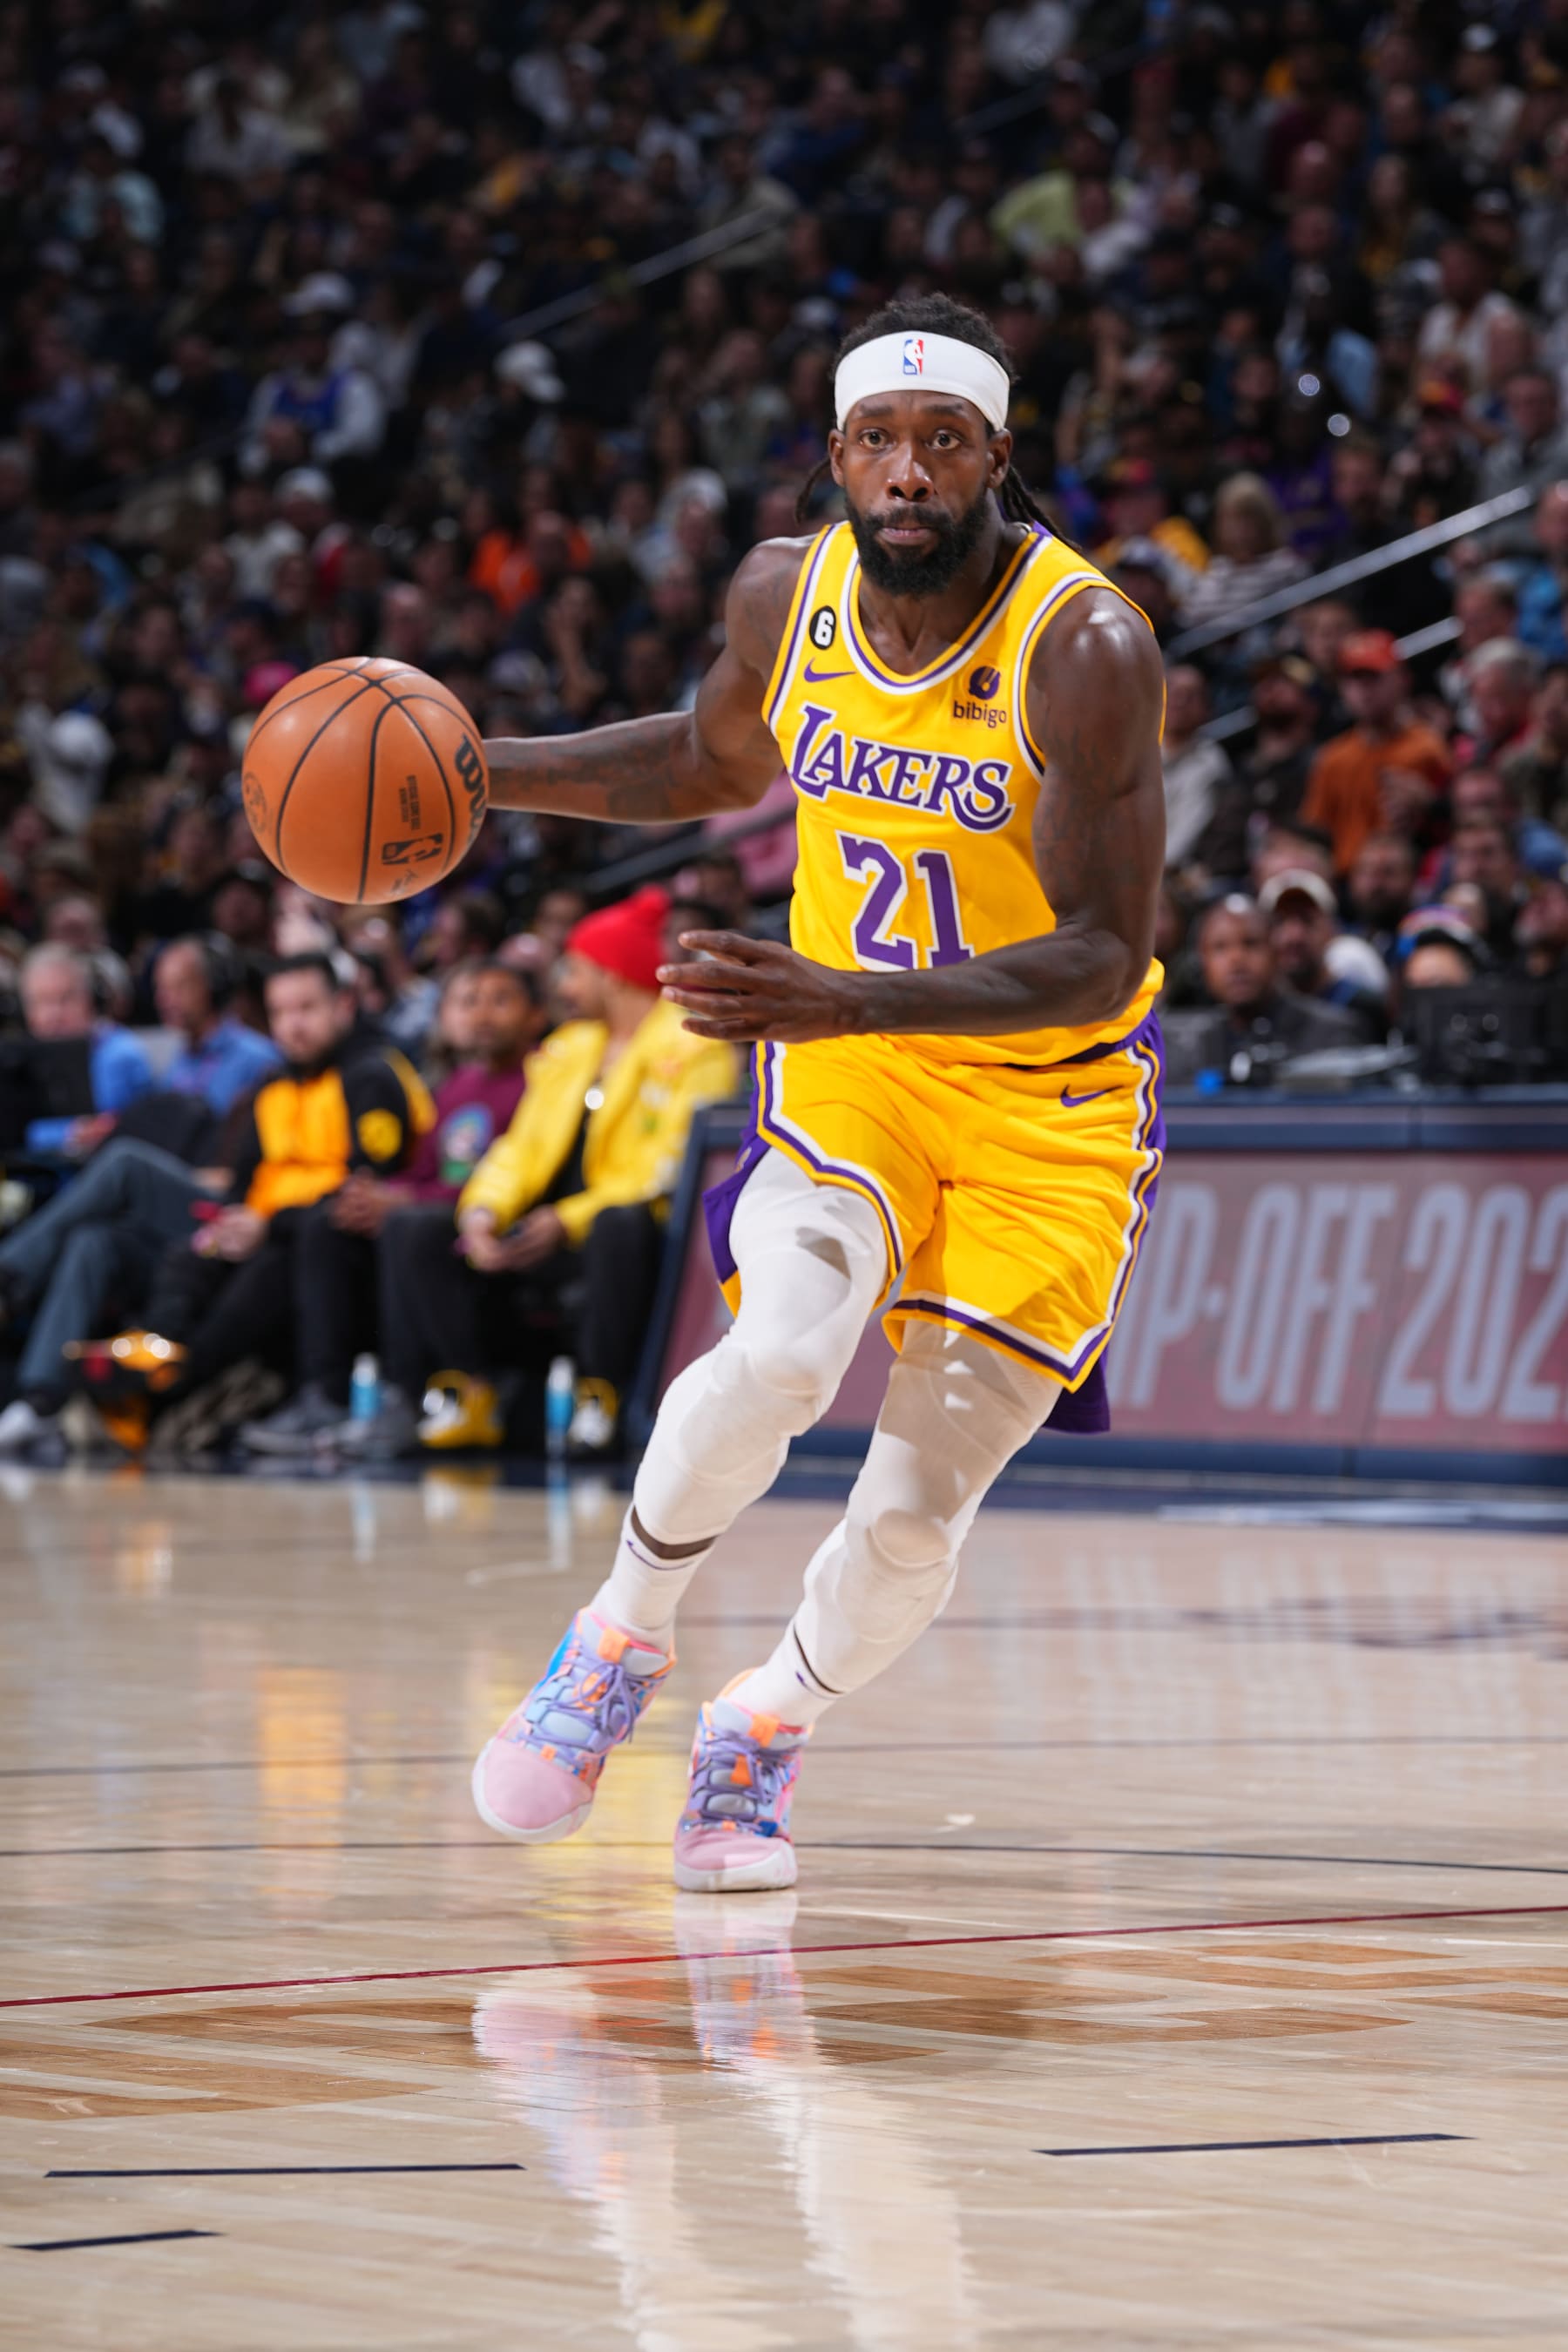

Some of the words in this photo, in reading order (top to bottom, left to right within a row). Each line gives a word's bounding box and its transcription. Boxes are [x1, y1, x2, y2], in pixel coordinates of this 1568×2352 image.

[814, 610, 835, 646] 6
[953, 700, 1007, 728] bibigo
[789, 702, 1015, 834] LAKERS
[835, 828, 977, 972] 21
